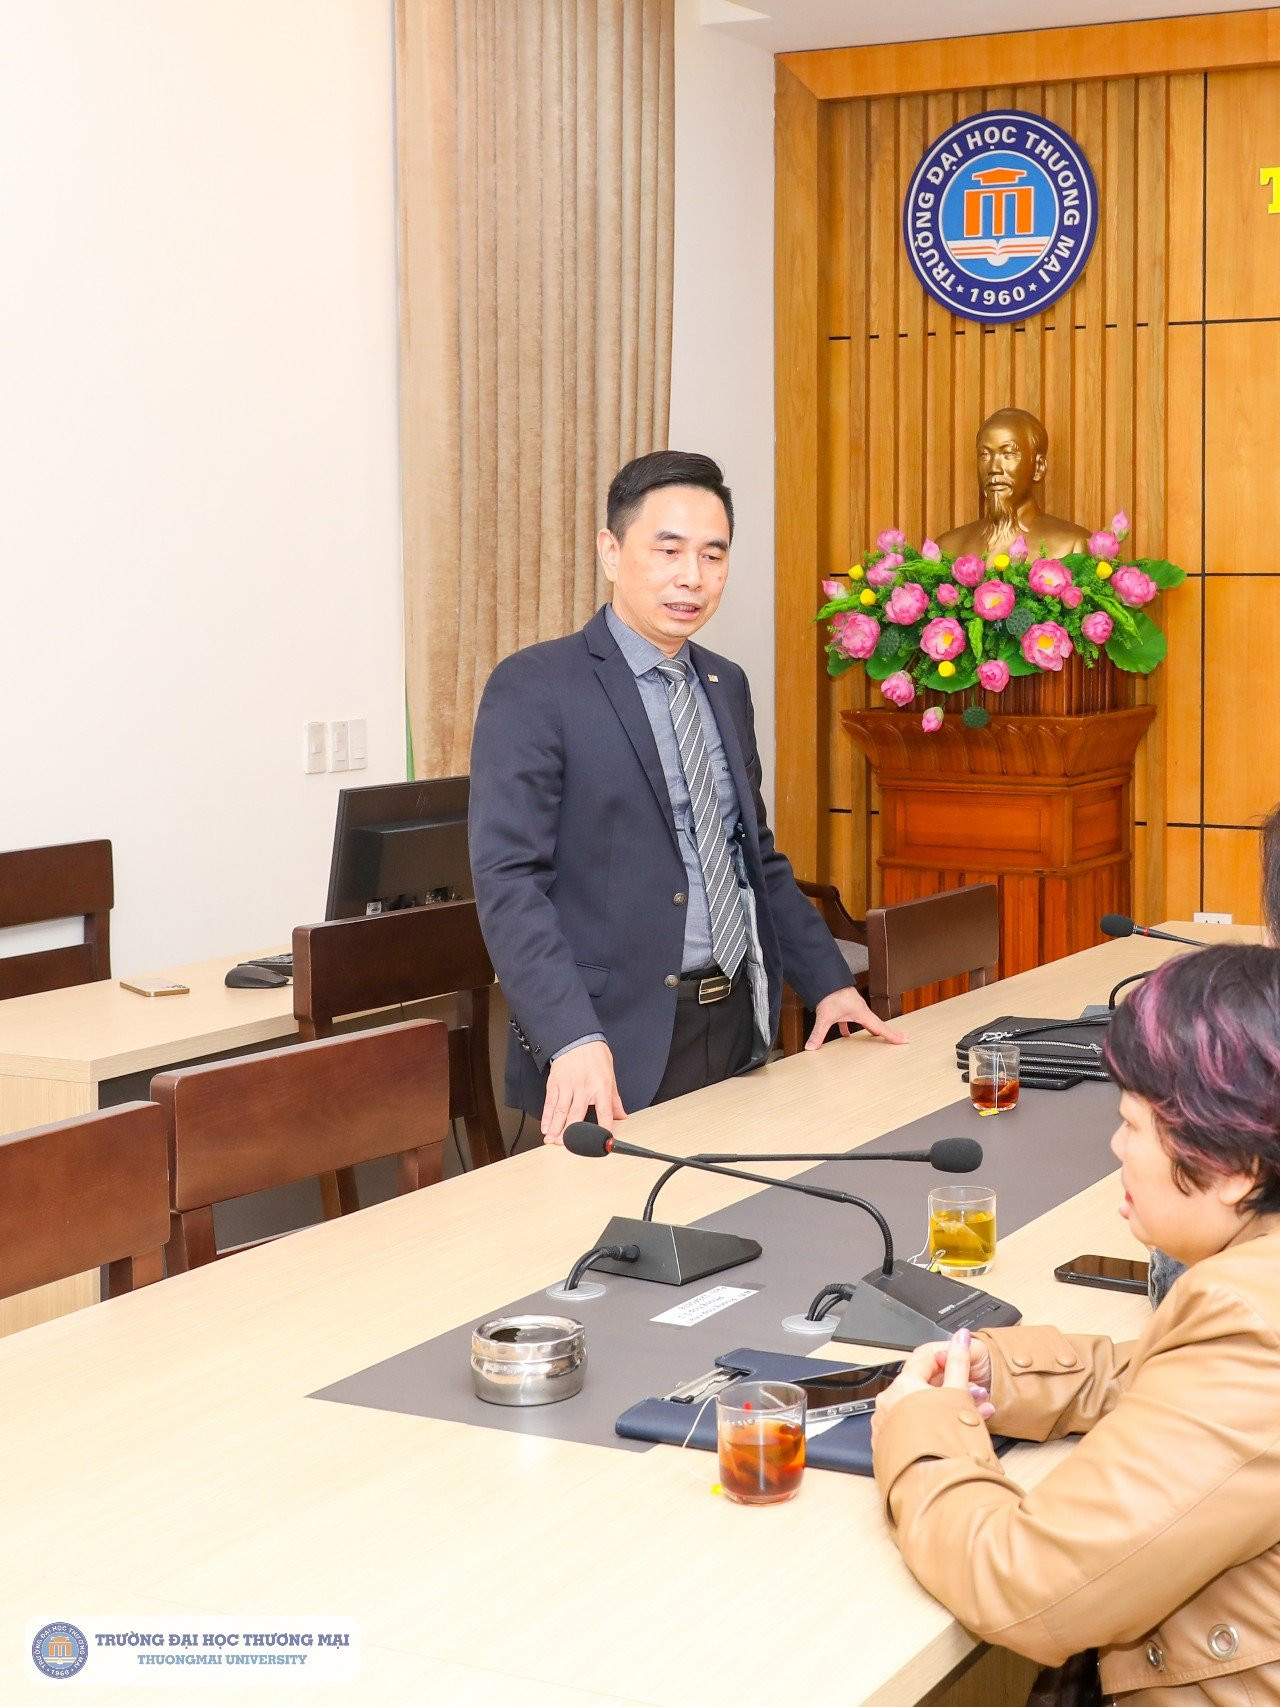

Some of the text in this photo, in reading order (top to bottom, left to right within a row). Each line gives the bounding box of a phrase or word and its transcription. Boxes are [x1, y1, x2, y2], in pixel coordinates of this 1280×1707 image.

[915, 126, 1081, 292] TRƯỜNG ĐẠI HỌC THƯƠNG MẠI
[970, 286, 1026, 305] 1960
